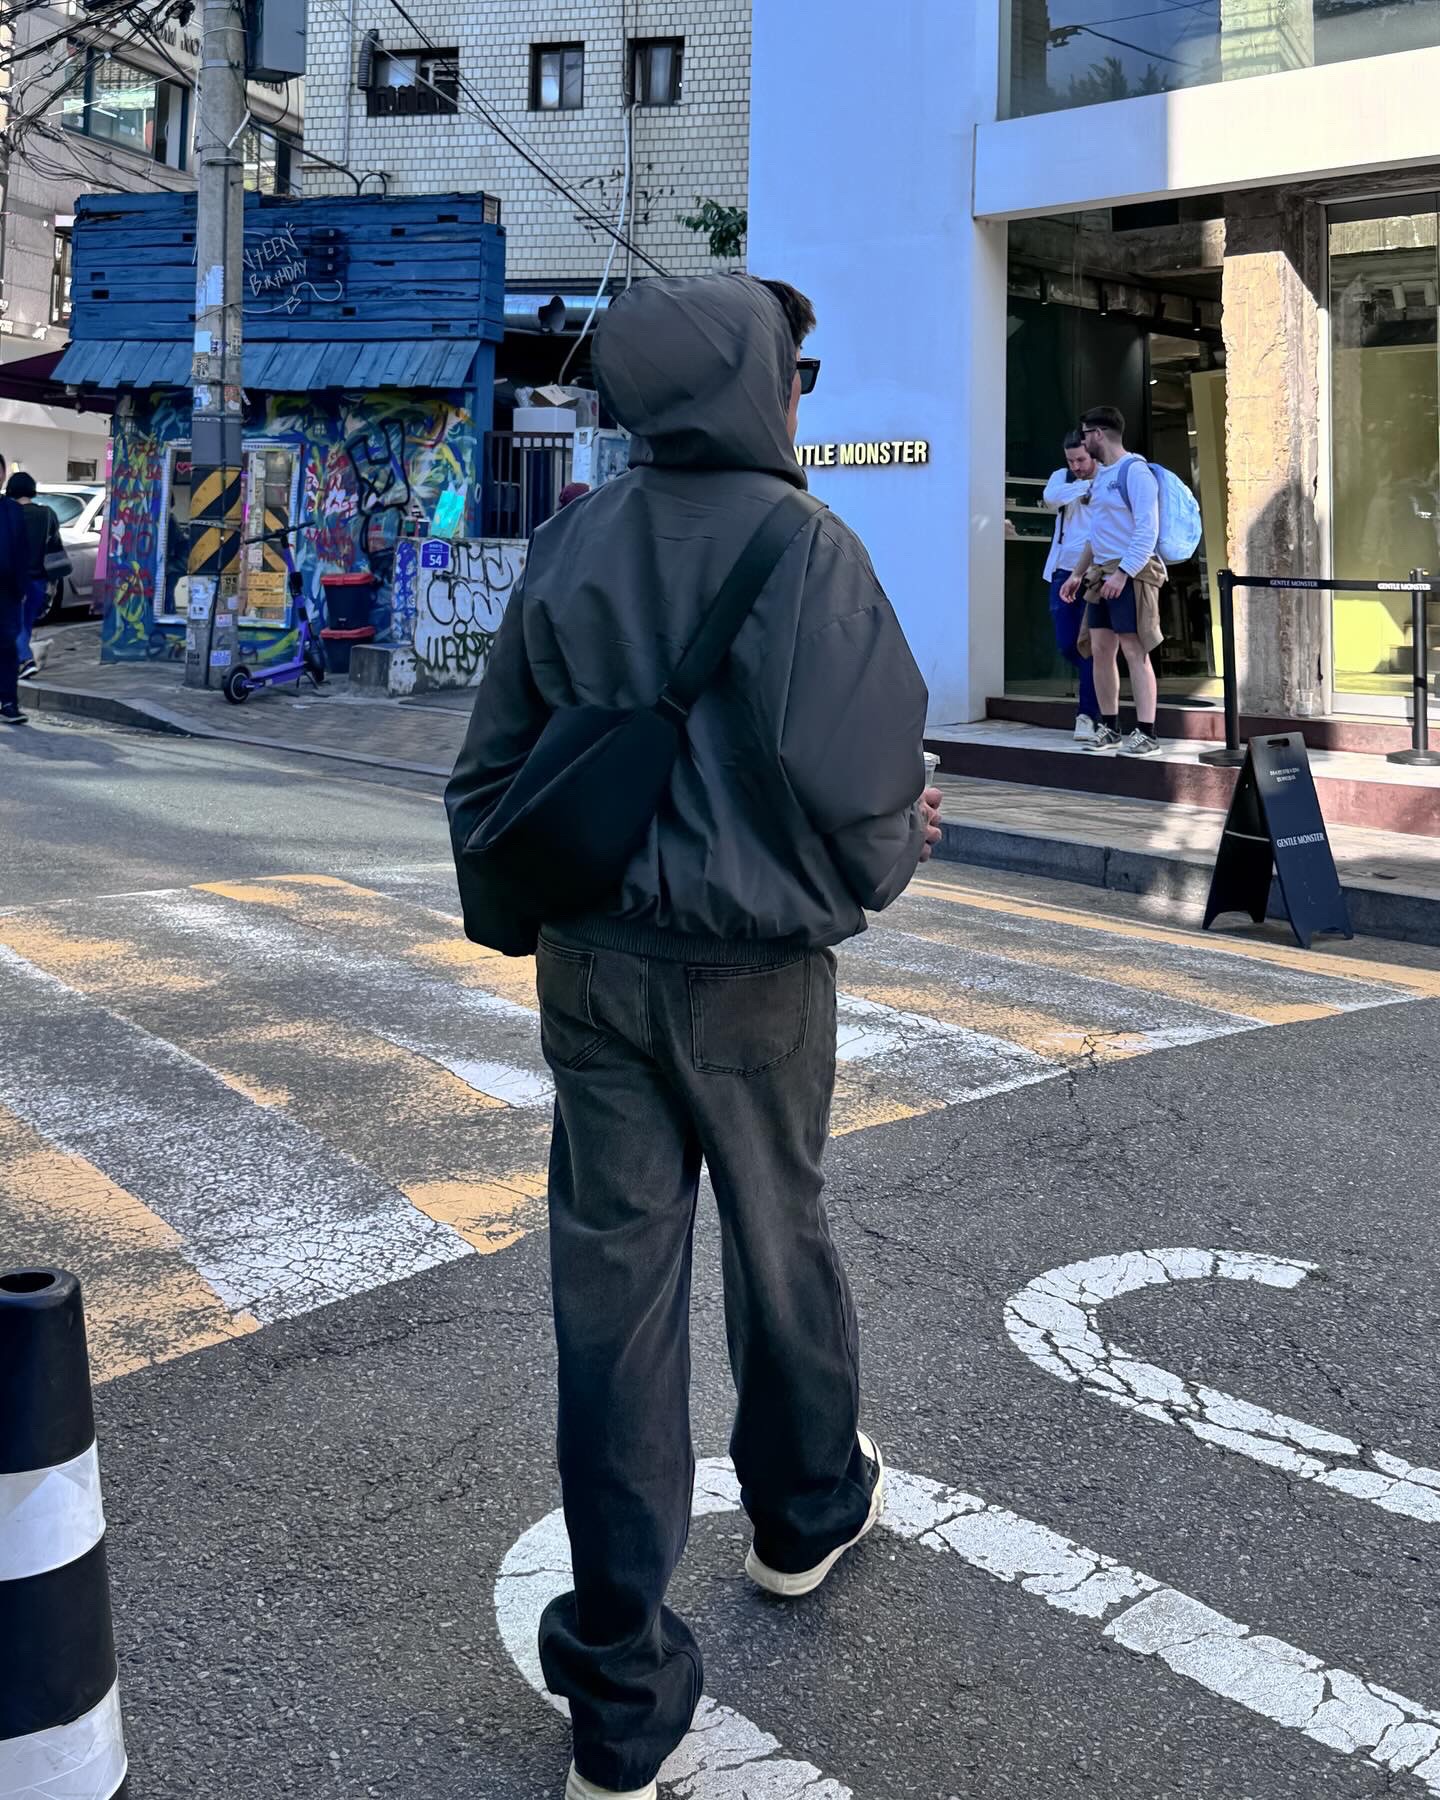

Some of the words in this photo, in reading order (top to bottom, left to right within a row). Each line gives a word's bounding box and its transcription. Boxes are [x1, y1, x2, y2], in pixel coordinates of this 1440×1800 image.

[794, 444, 836, 467] NTLE
[839, 440, 928, 466] MONSTER
[429, 554, 442, 567] 54
[1276, 836, 1298, 848] GENTLE
[1297, 832, 1325, 844] MONSTER
